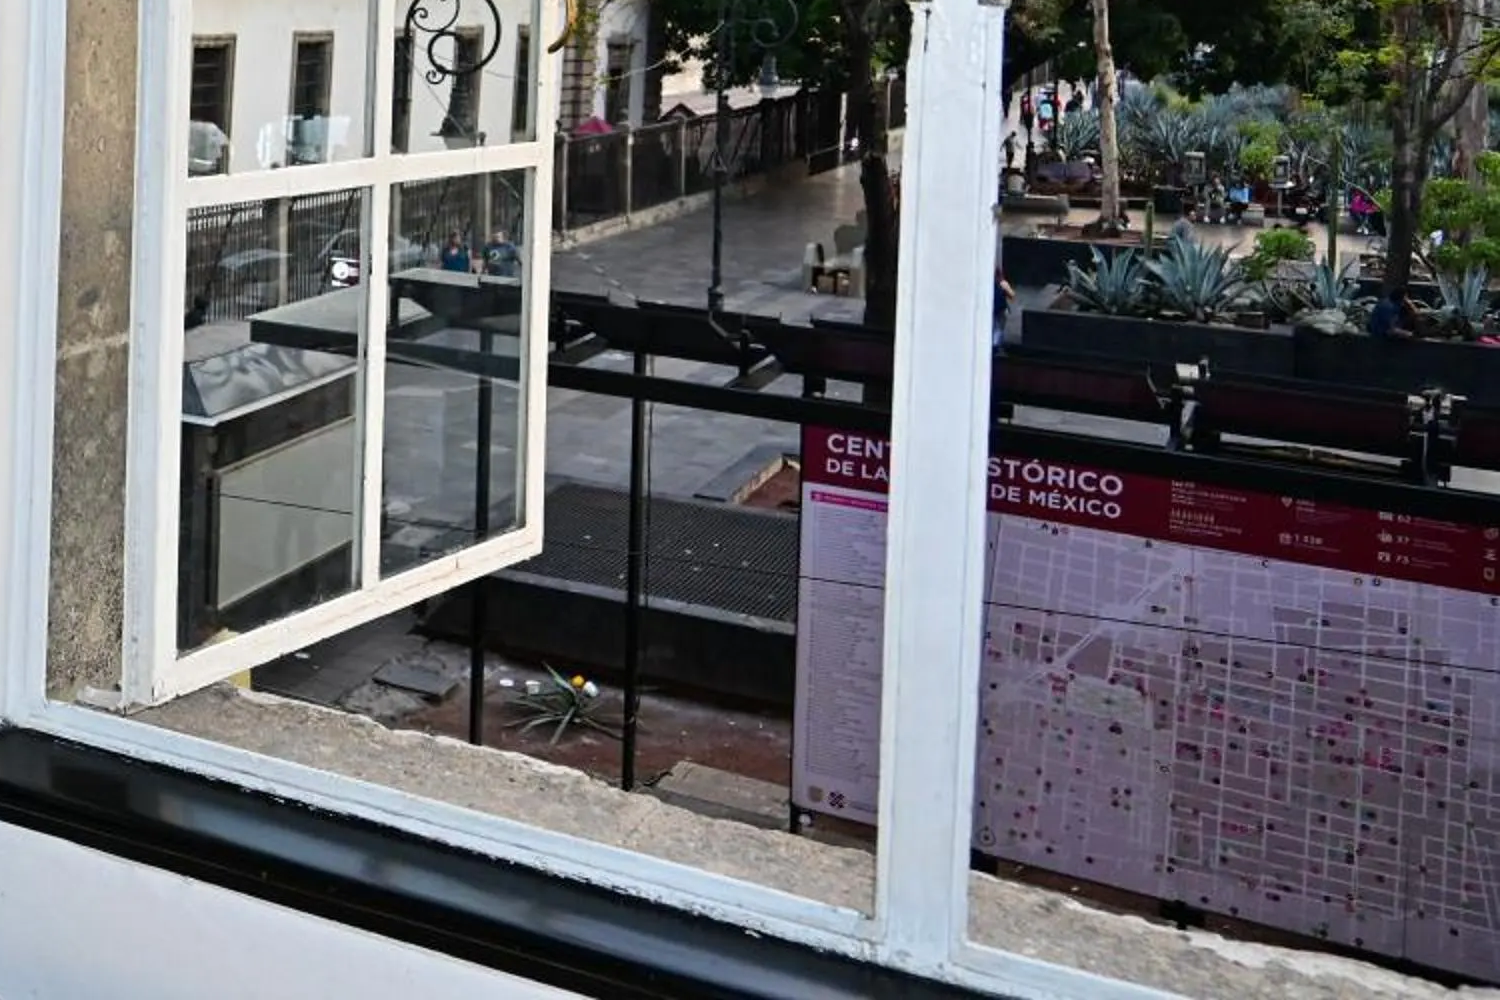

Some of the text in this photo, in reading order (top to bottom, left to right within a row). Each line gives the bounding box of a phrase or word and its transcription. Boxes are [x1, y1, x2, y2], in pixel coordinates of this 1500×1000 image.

[826, 457, 1122, 519] DE LA DE MÉXICO
[827, 433, 1124, 496] CEN STÓRICO
